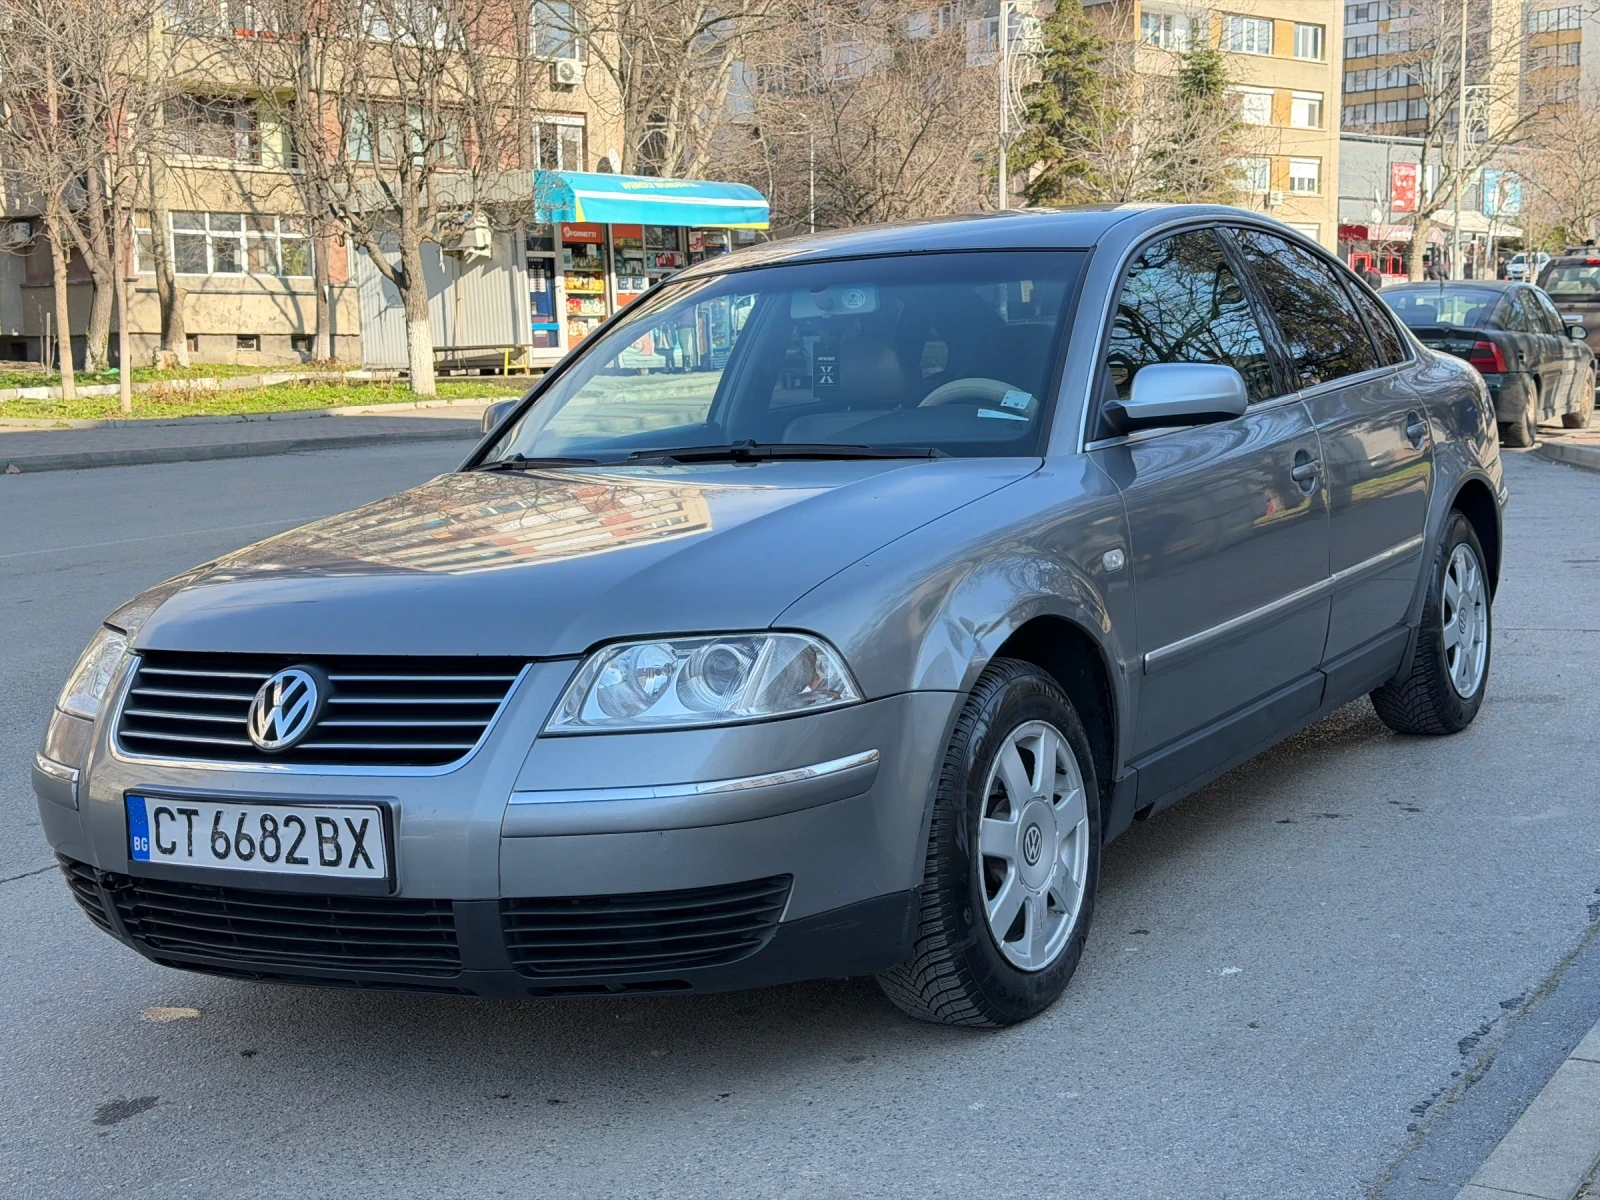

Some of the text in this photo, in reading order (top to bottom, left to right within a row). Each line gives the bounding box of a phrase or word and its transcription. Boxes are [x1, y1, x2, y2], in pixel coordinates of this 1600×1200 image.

[570, 230, 597, 238] FORNETTI
[133, 836, 148, 852] BG
[153, 806, 375, 869] CT 6682 BX
